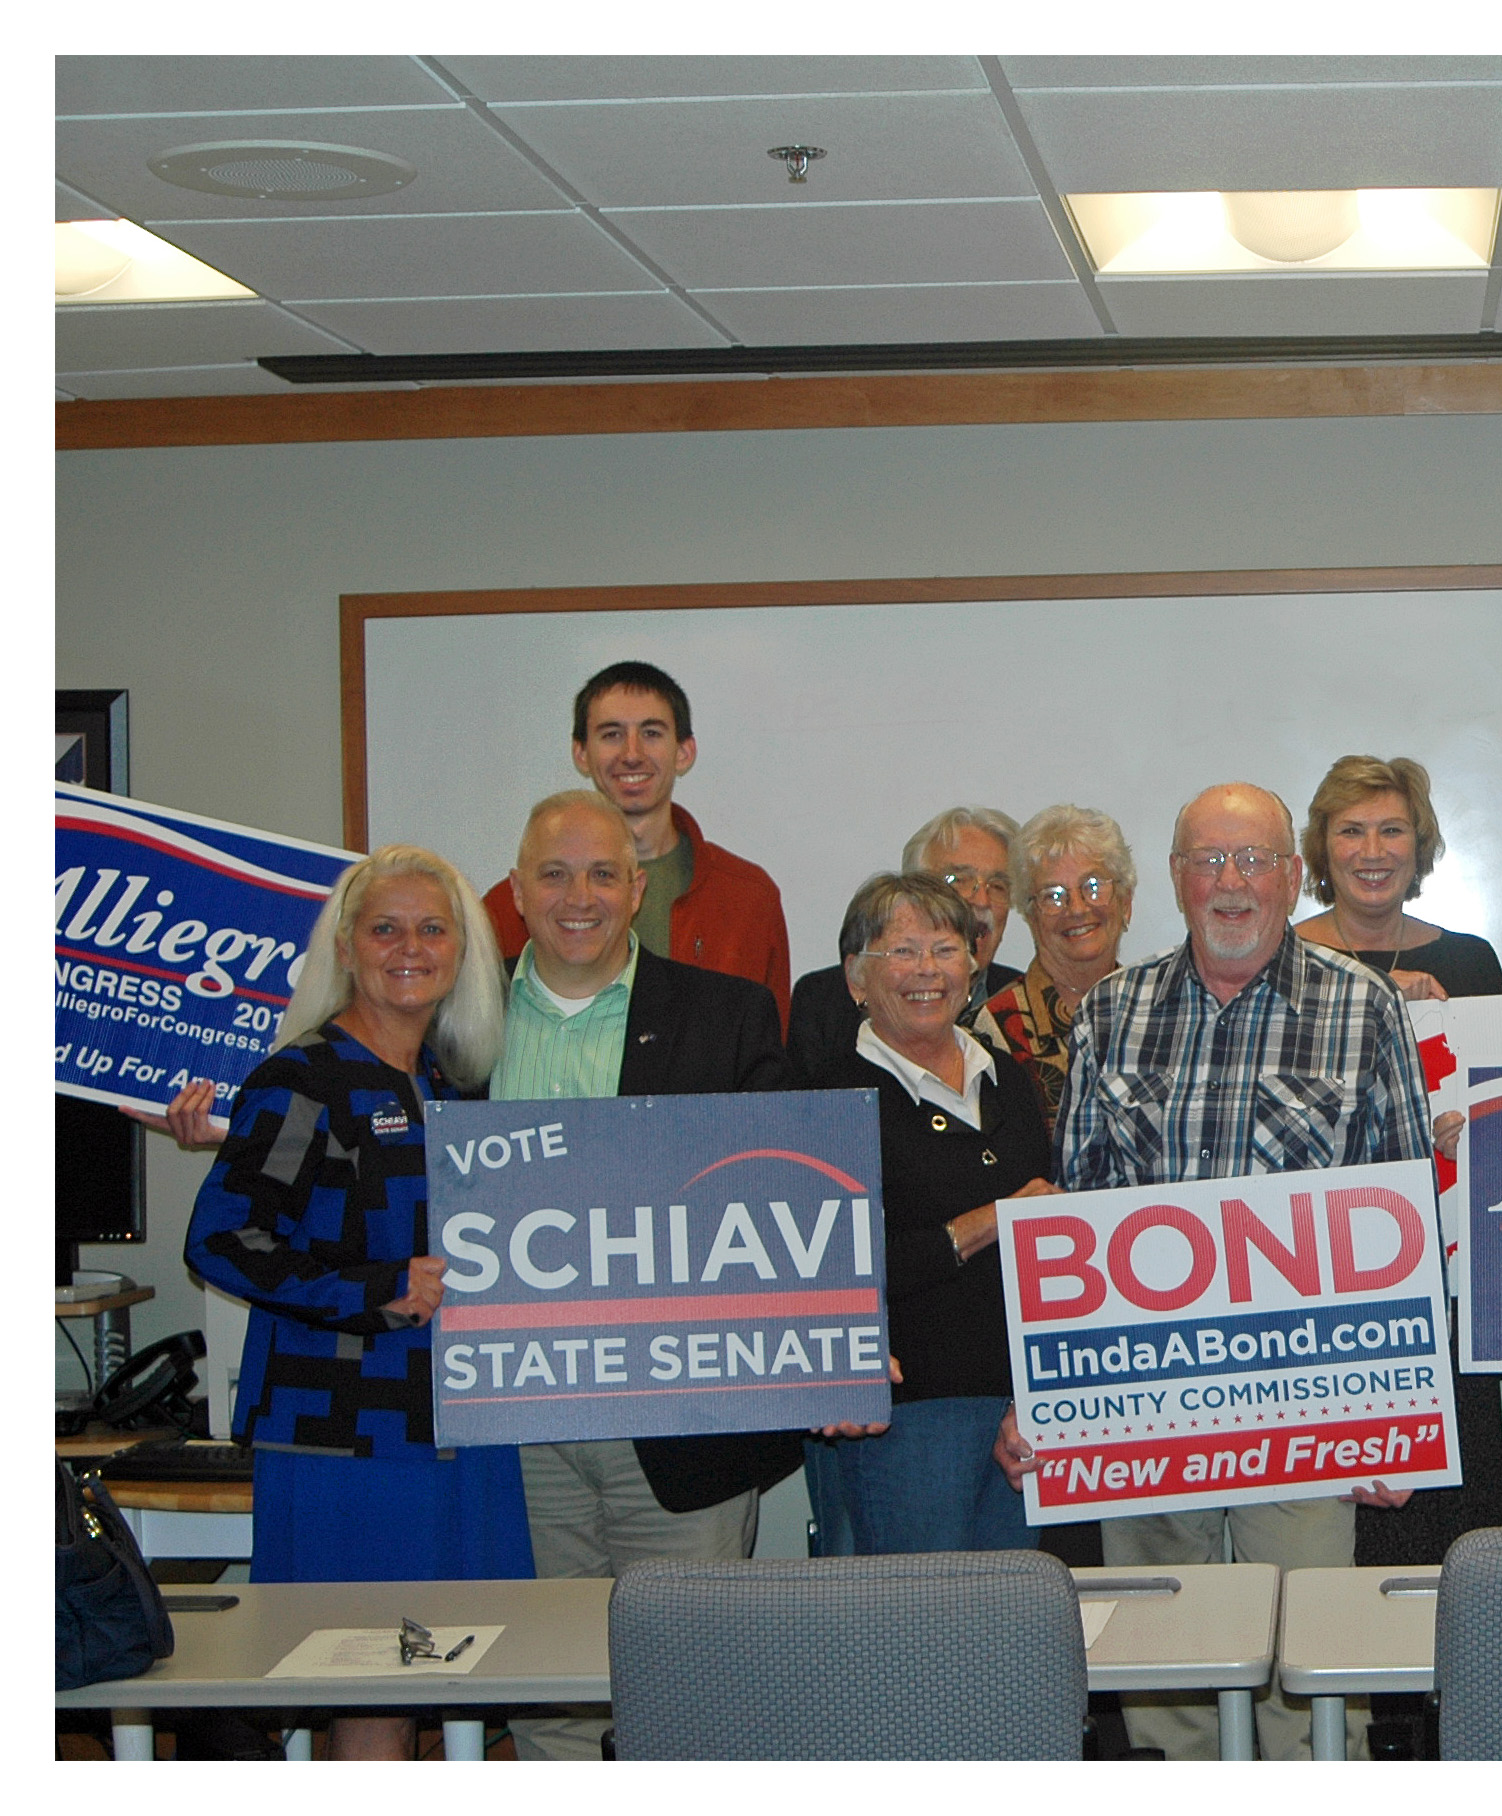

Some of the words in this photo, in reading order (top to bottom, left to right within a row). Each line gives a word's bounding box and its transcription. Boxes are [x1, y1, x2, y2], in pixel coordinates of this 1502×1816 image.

[56, 991, 275, 1055] lliegroForCongress.
[76, 1046, 113, 1076] Up
[118, 1056, 166, 1084] For
[446, 1122, 568, 1175] VOTE
[441, 1198, 873, 1293] SCHIAVI
[1012, 1187, 1426, 1323] BOND
[443, 1337, 628, 1391] STATE
[649, 1326, 883, 1381] SENATE
[1029, 1316, 1430, 1381] LindaABond.com
[1031, 1391, 1167, 1425] COUNTY
[1179, 1366, 1436, 1411] COMMISSIONER
[1182, 1439, 1270, 1482] and
